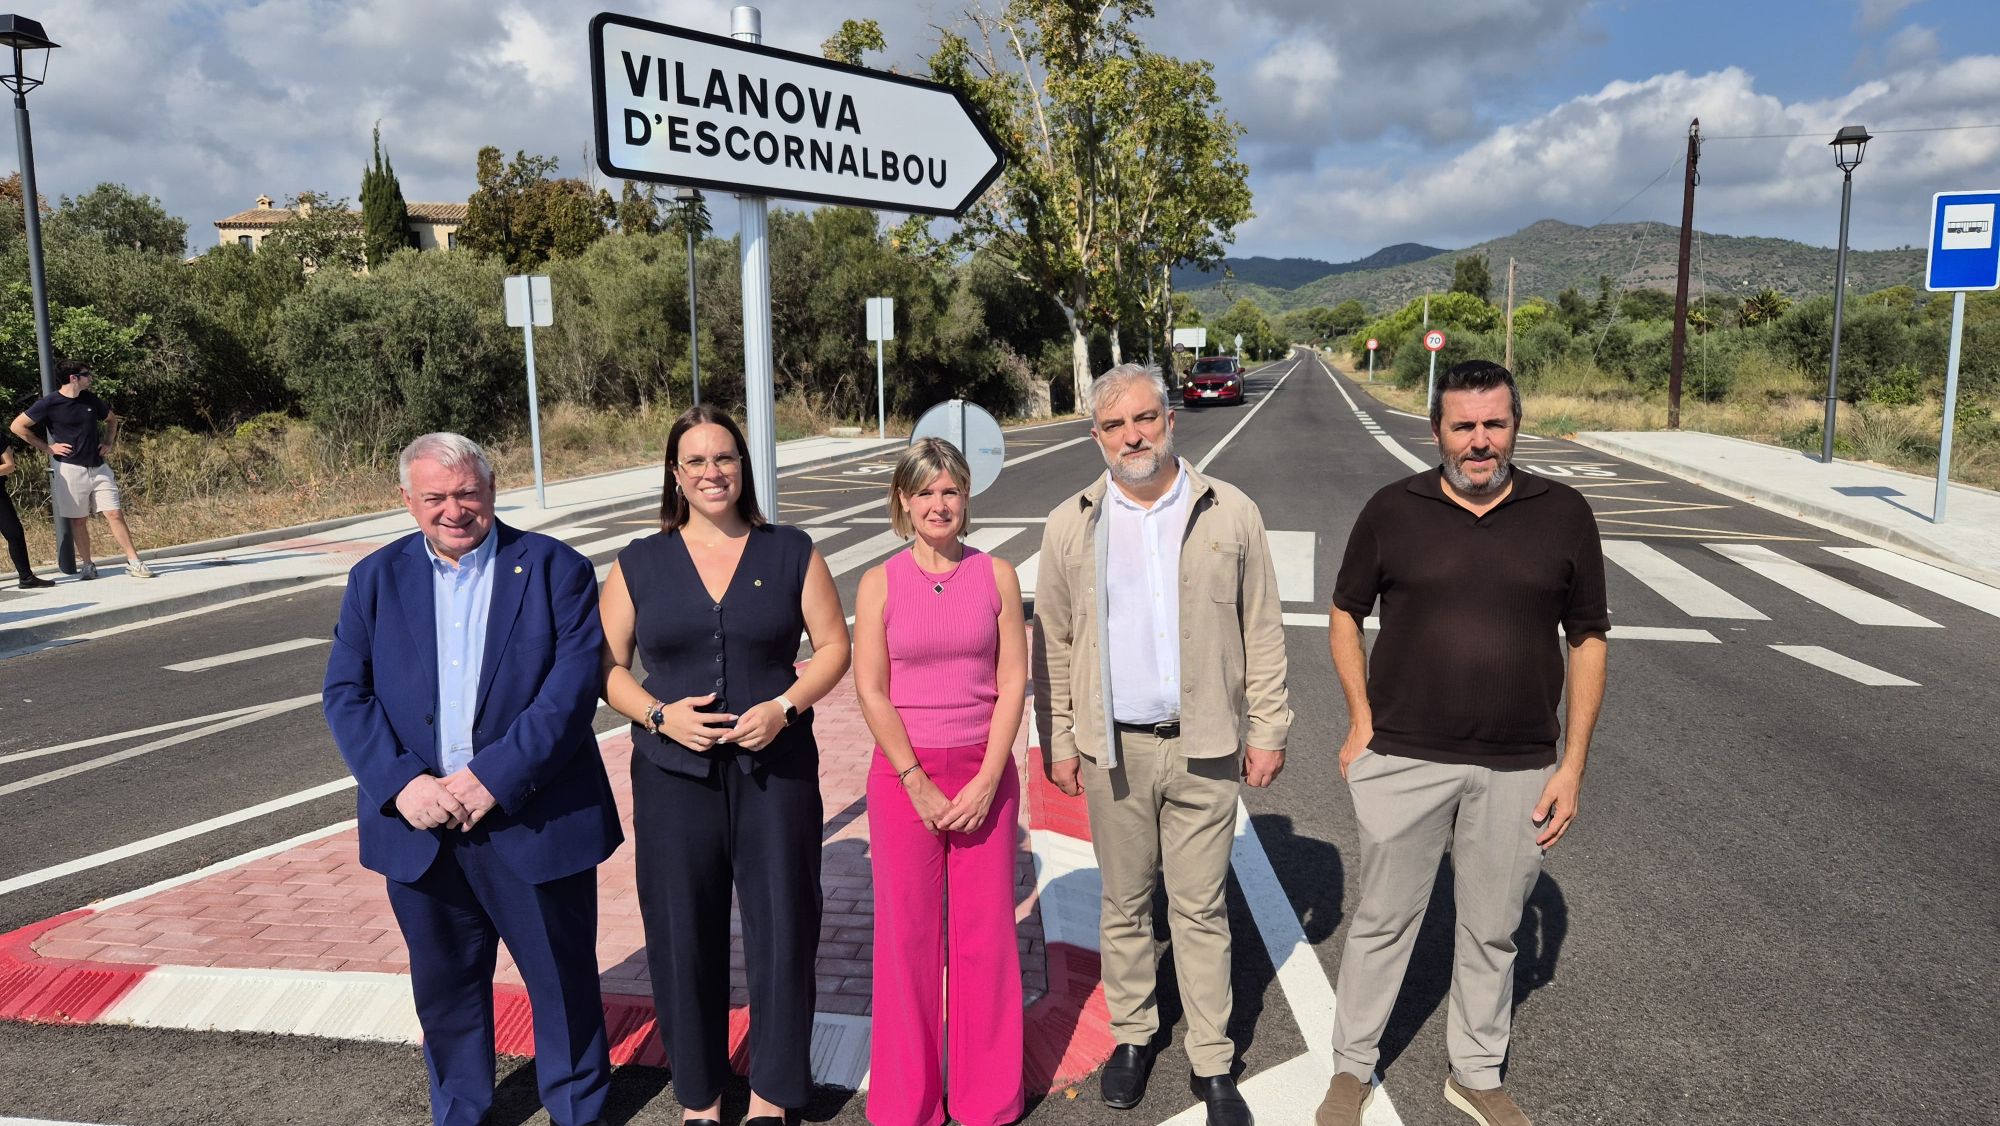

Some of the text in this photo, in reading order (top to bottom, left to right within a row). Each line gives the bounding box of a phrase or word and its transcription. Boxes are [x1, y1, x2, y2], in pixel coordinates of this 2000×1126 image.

[621, 51, 861, 134] VILANOVA
[624, 108, 947, 188] D'ESCORNALBOU
[1429, 336, 1441, 344] 70
[1517, 465, 1618, 477] US
